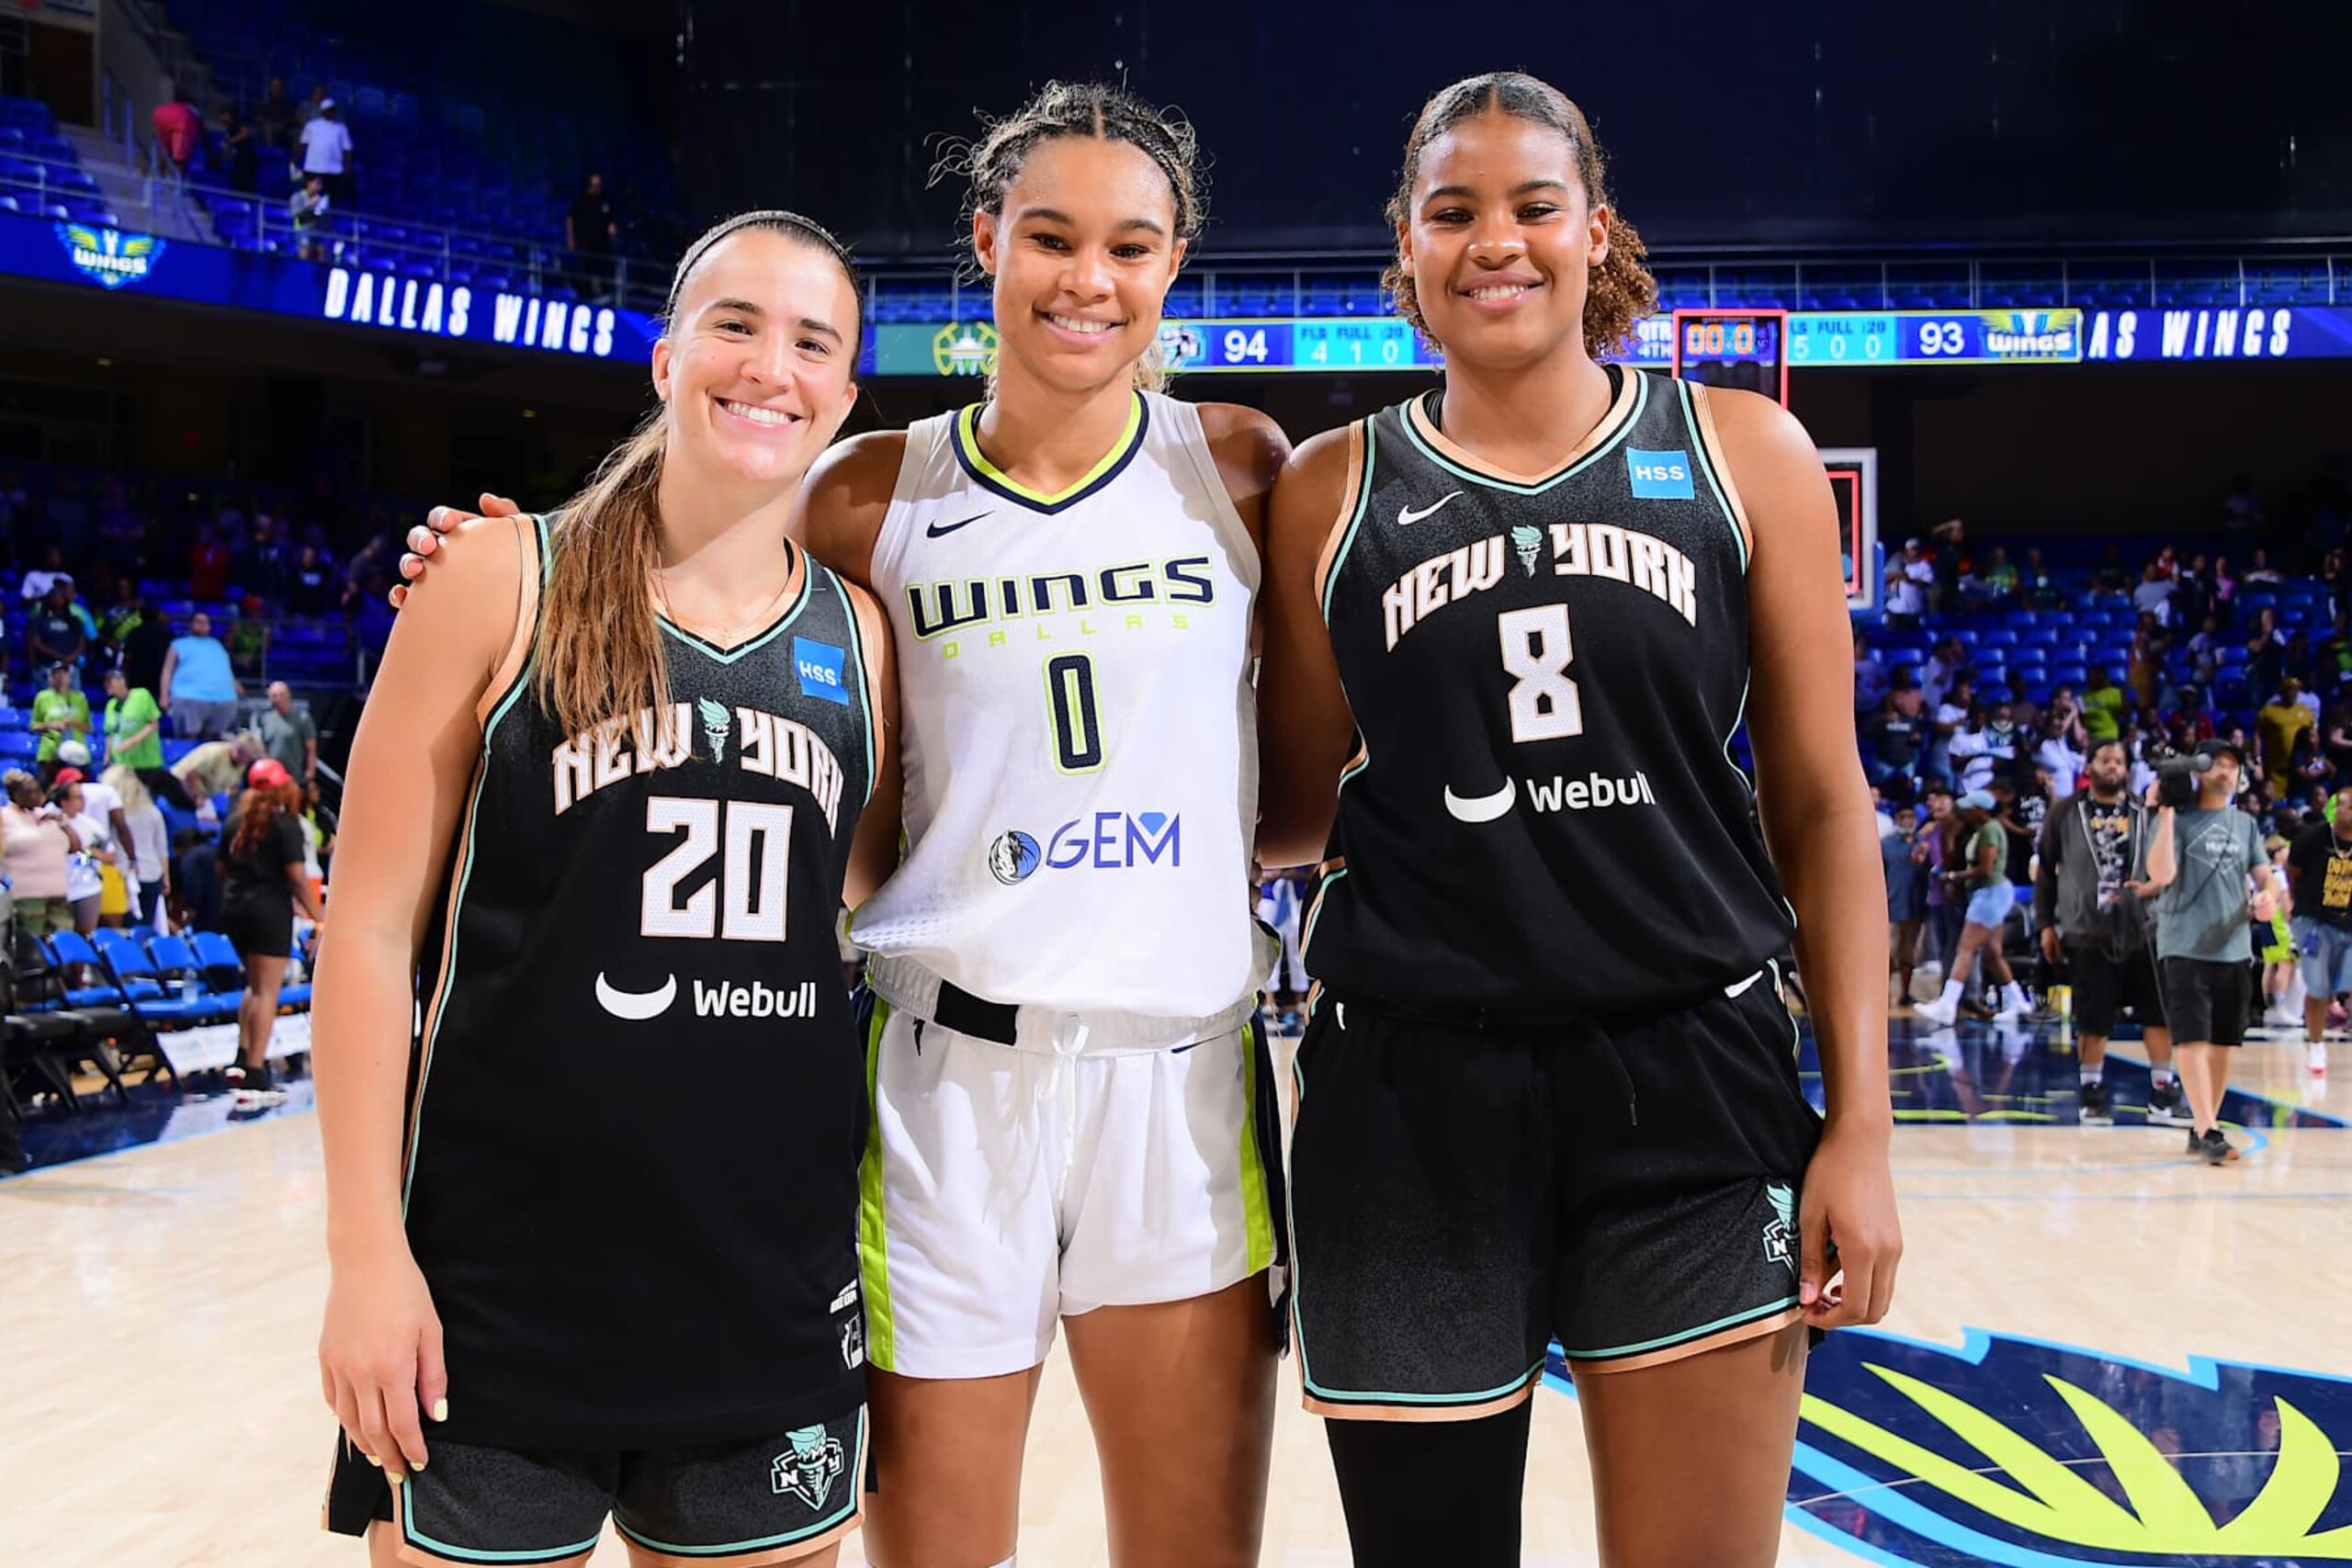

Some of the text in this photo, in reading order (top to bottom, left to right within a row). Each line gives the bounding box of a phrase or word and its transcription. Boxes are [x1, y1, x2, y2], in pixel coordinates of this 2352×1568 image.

[324, 268, 616, 356] DALLAS WINGS
[1817, 321, 1853, 335] FULL
[1223, 329, 1269, 364] 94
[1310, 340, 1399, 364] 4 1 0
[1338, 327, 1372, 341] FULL
[1793, 334, 1882, 359] 5 0 0
[1919, 321, 1965, 355] 93
[2162, 309, 2291, 357] WINGS
[1635, 465, 1685, 481] HSS
[905, 554, 1218, 641] WINGS
[1382, 523, 1697, 653] NEW YORK
[943, 613, 1190, 660] DALLAS
[799, 660, 837, 686] HSS
[1498, 603, 1583, 744] 8
[1042, 649, 1109, 776] 0
[553, 702, 844, 840] NEW YORK
[1526, 771, 1657, 813] Webull
[1046, 812, 1181, 869] GEM
[640, 795, 794, 942] 20
[693, 980, 817, 1018] Webull
[1771, 1238, 1788, 1257] N
[779, 1472, 799, 1488] N
